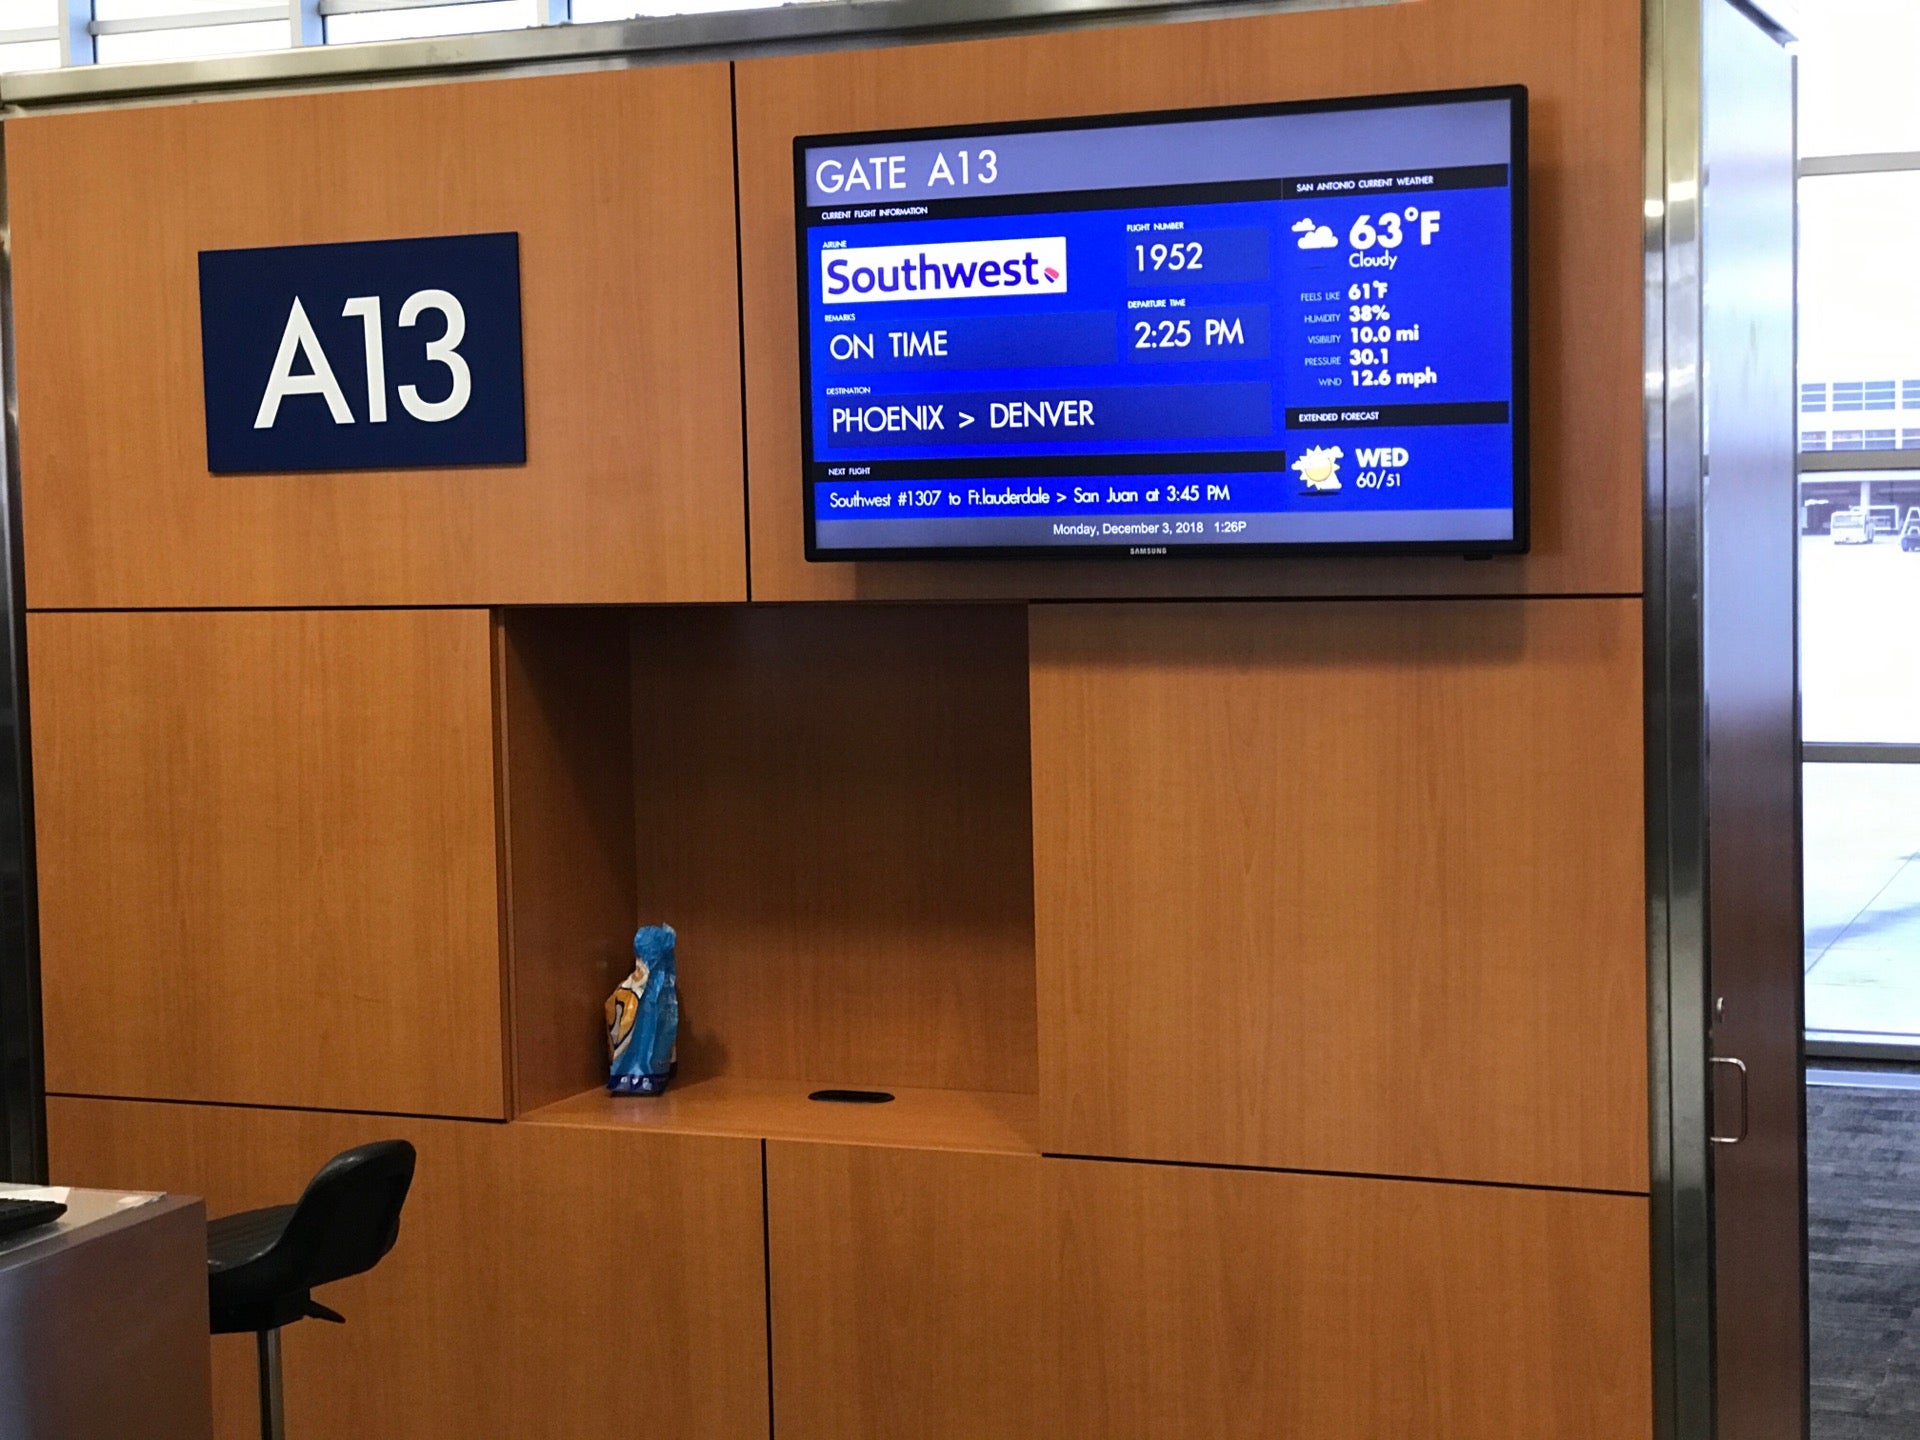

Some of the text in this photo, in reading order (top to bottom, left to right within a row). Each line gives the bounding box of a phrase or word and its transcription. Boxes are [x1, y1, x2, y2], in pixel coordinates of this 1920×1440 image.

[816, 150, 997, 193] GATE A13
[1297, 176, 1433, 192] SAN ANTONIO CURRENT WEATHER
[822, 207, 928, 220] CURRENT FLIGHT INFORMATION
[1127, 222, 1184, 232] FLIGHT NUMBER
[822, 240, 847, 249] AIRLINE
[1136, 242, 1202, 271] 1952
[1349, 250, 1397, 270] Cloudy
[826, 251, 1039, 294] Southwest
[1128, 300, 1166, 308] DEPARTURE
[1301, 292, 1340, 301] FEELS LIKE
[825, 313, 855, 322] REMARKS
[1304, 314, 1340, 323] HUMIDITY
[1349, 305, 1390, 322] 38%
[1135, 318, 1244, 348] 2:25 PM
[1308, 335, 1341, 344] VISIBILITY
[1351, 324, 1419, 343] 10.0 mi
[830, 331, 947, 360] ON TIME
[253, 288, 472, 429] A13
[1305, 357, 1341, 366] PRESSURE
[1350, 348, 1388, 365] 30.1
[1318, 378, 1342, 386] WIND
[1352, 367, 1437, 388] 12.6 mph
[826, 387, 870, 395] DESTINATION
[833, 405, 944, 432] PHOENIX
[991, 400, 1094, 428] DENVER
[1299, 412, 1379, 422] EXTENDED FORECAST
[1356, 448, 1409, 467] WED
[849, 467, 870, 475] FLIGHT
[1356, 470, 1400, 489] 60/51
[830, 490, 891, 507] Southwest
[898, 490, 941, 506] #1307
[949, 493, 961, 505] to
[1074, 487, 1099, 503] San
[1107, 487, 1138, 502] Juan
[1146, 488, 1159, 501] at
[1167, 485, 1199, 501] 3:45
[1207, 485, 1230, 500] PM
[1054, 521, 1246, 537] Monday, December 3, 2018 1:26P
